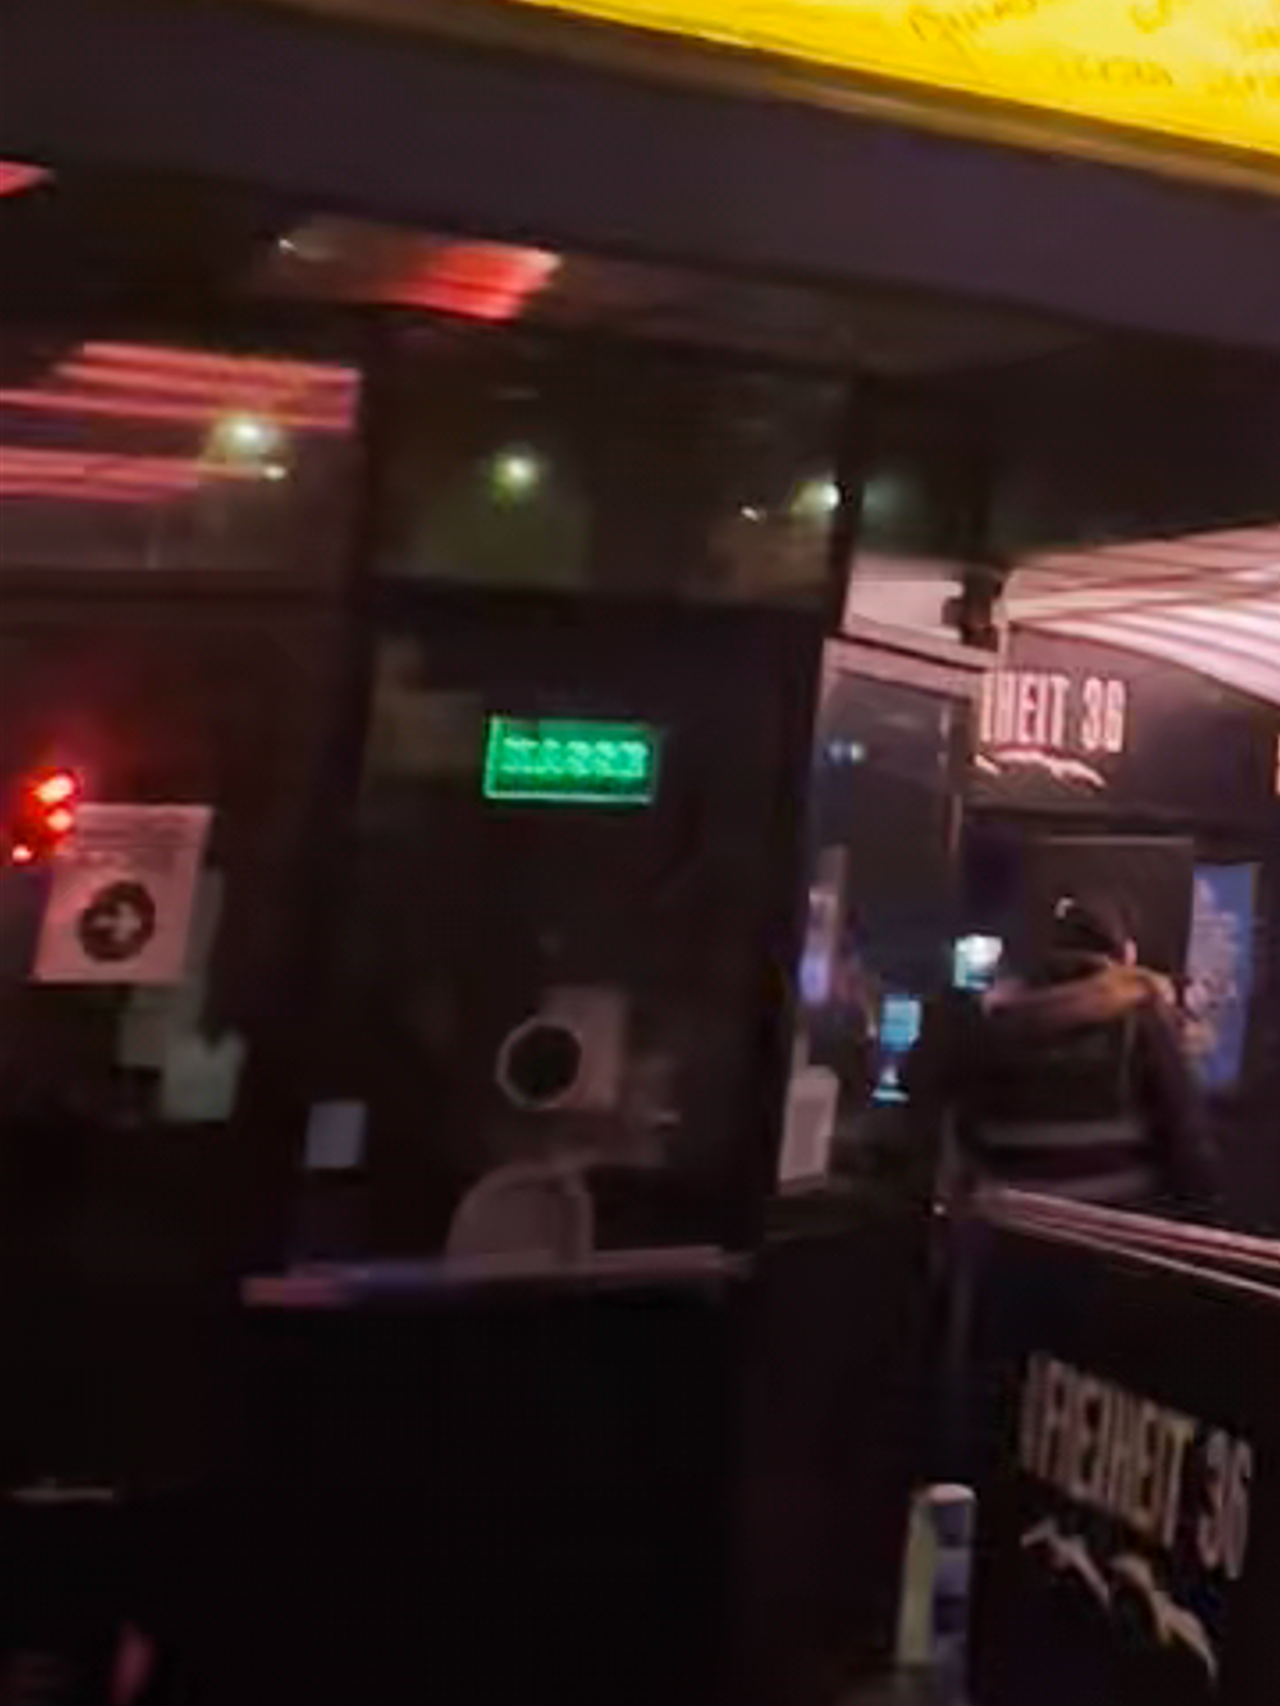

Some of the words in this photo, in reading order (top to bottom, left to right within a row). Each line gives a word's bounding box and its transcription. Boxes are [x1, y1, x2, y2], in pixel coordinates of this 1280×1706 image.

[979, 671, 1071, 747] IHEIT
[1081, 676, 1126, 753] 36
[1038, 1357, 1195, 1551] FREIHEIT
[1197, 1427, 1253, 1581] 36
